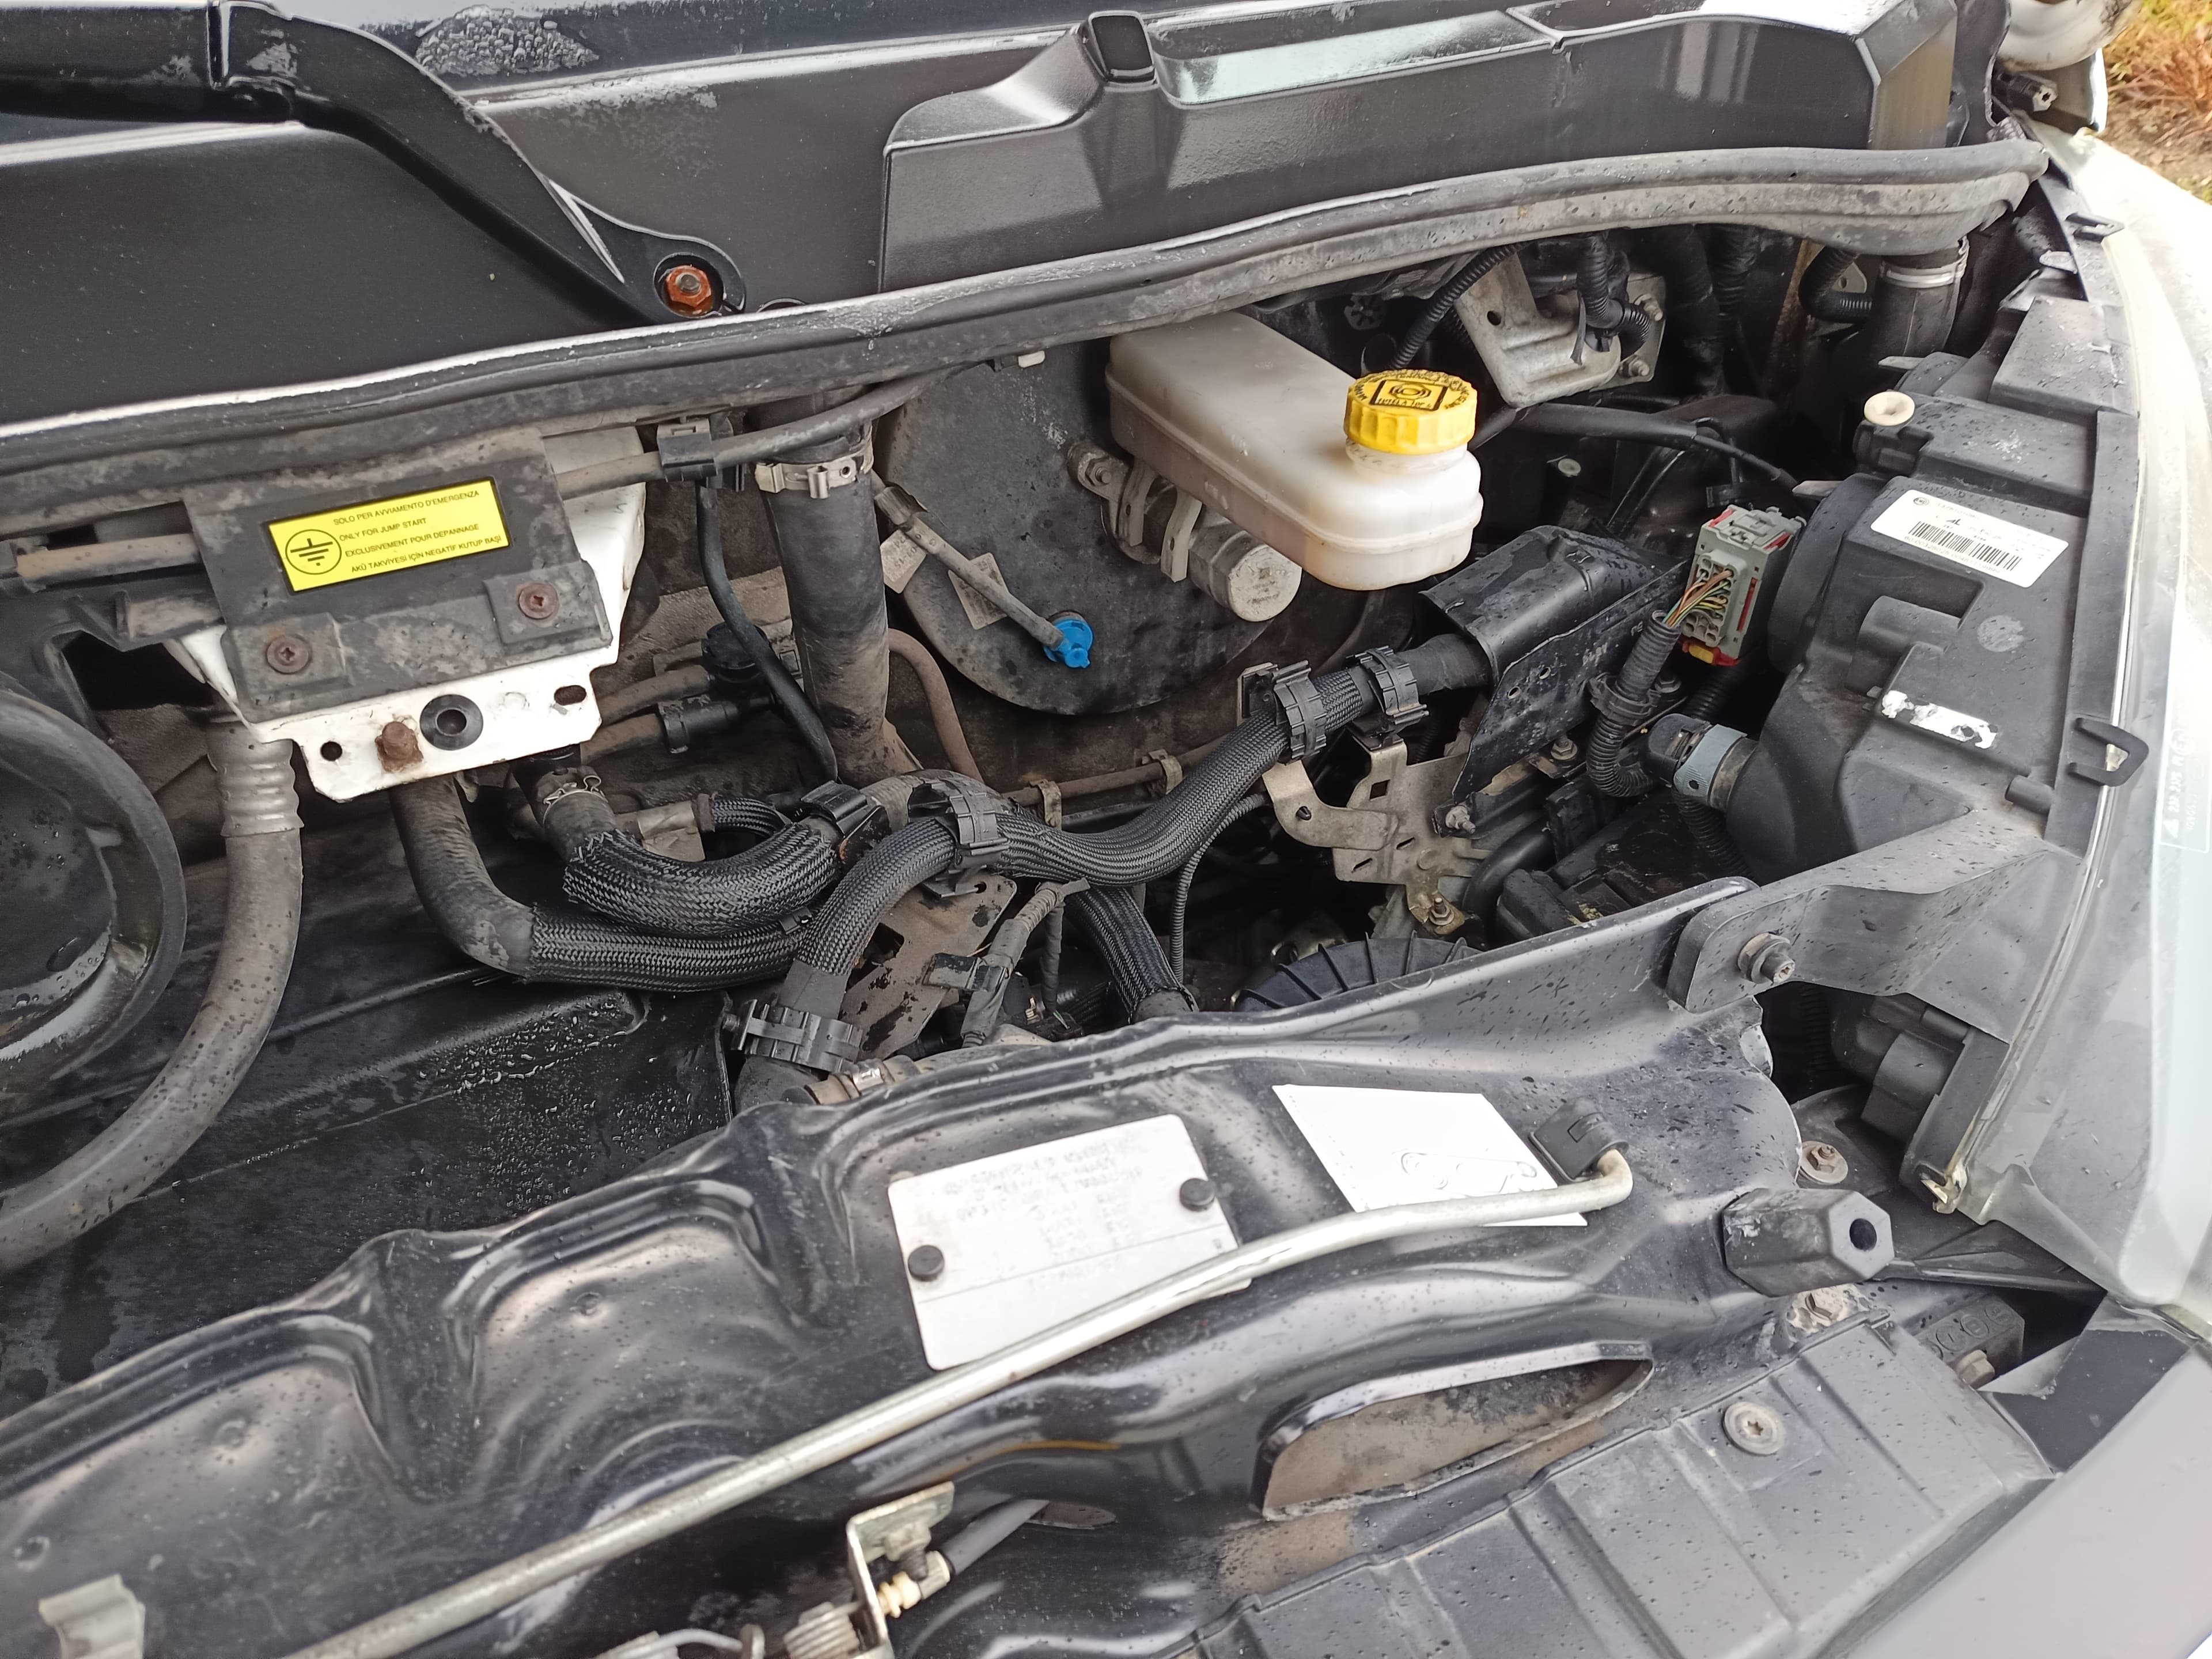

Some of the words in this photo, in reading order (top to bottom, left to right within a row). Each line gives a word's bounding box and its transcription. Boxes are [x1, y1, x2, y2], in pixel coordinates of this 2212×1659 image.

[334, 516, 355, 525] SOLO
[357, 512, 373, 521] PER
[375, 502, 423, 517] AVVIAMENTO
[426, 490, 479, 506] D'EMERGENZA
[339, 532, 359, 541] ONLY
[362, 528, 379, 536] FOR
[380, 524, 400, 534] JUMP
[403, 518, 426, 529] START
[346, 539, 408, 557] EXCLUSIVEMENT
[410, 533, 432, 544] POUR
[434, 524, 479, 539] DEPANNAGE
[459, 540, 483, 550] KUTUP
